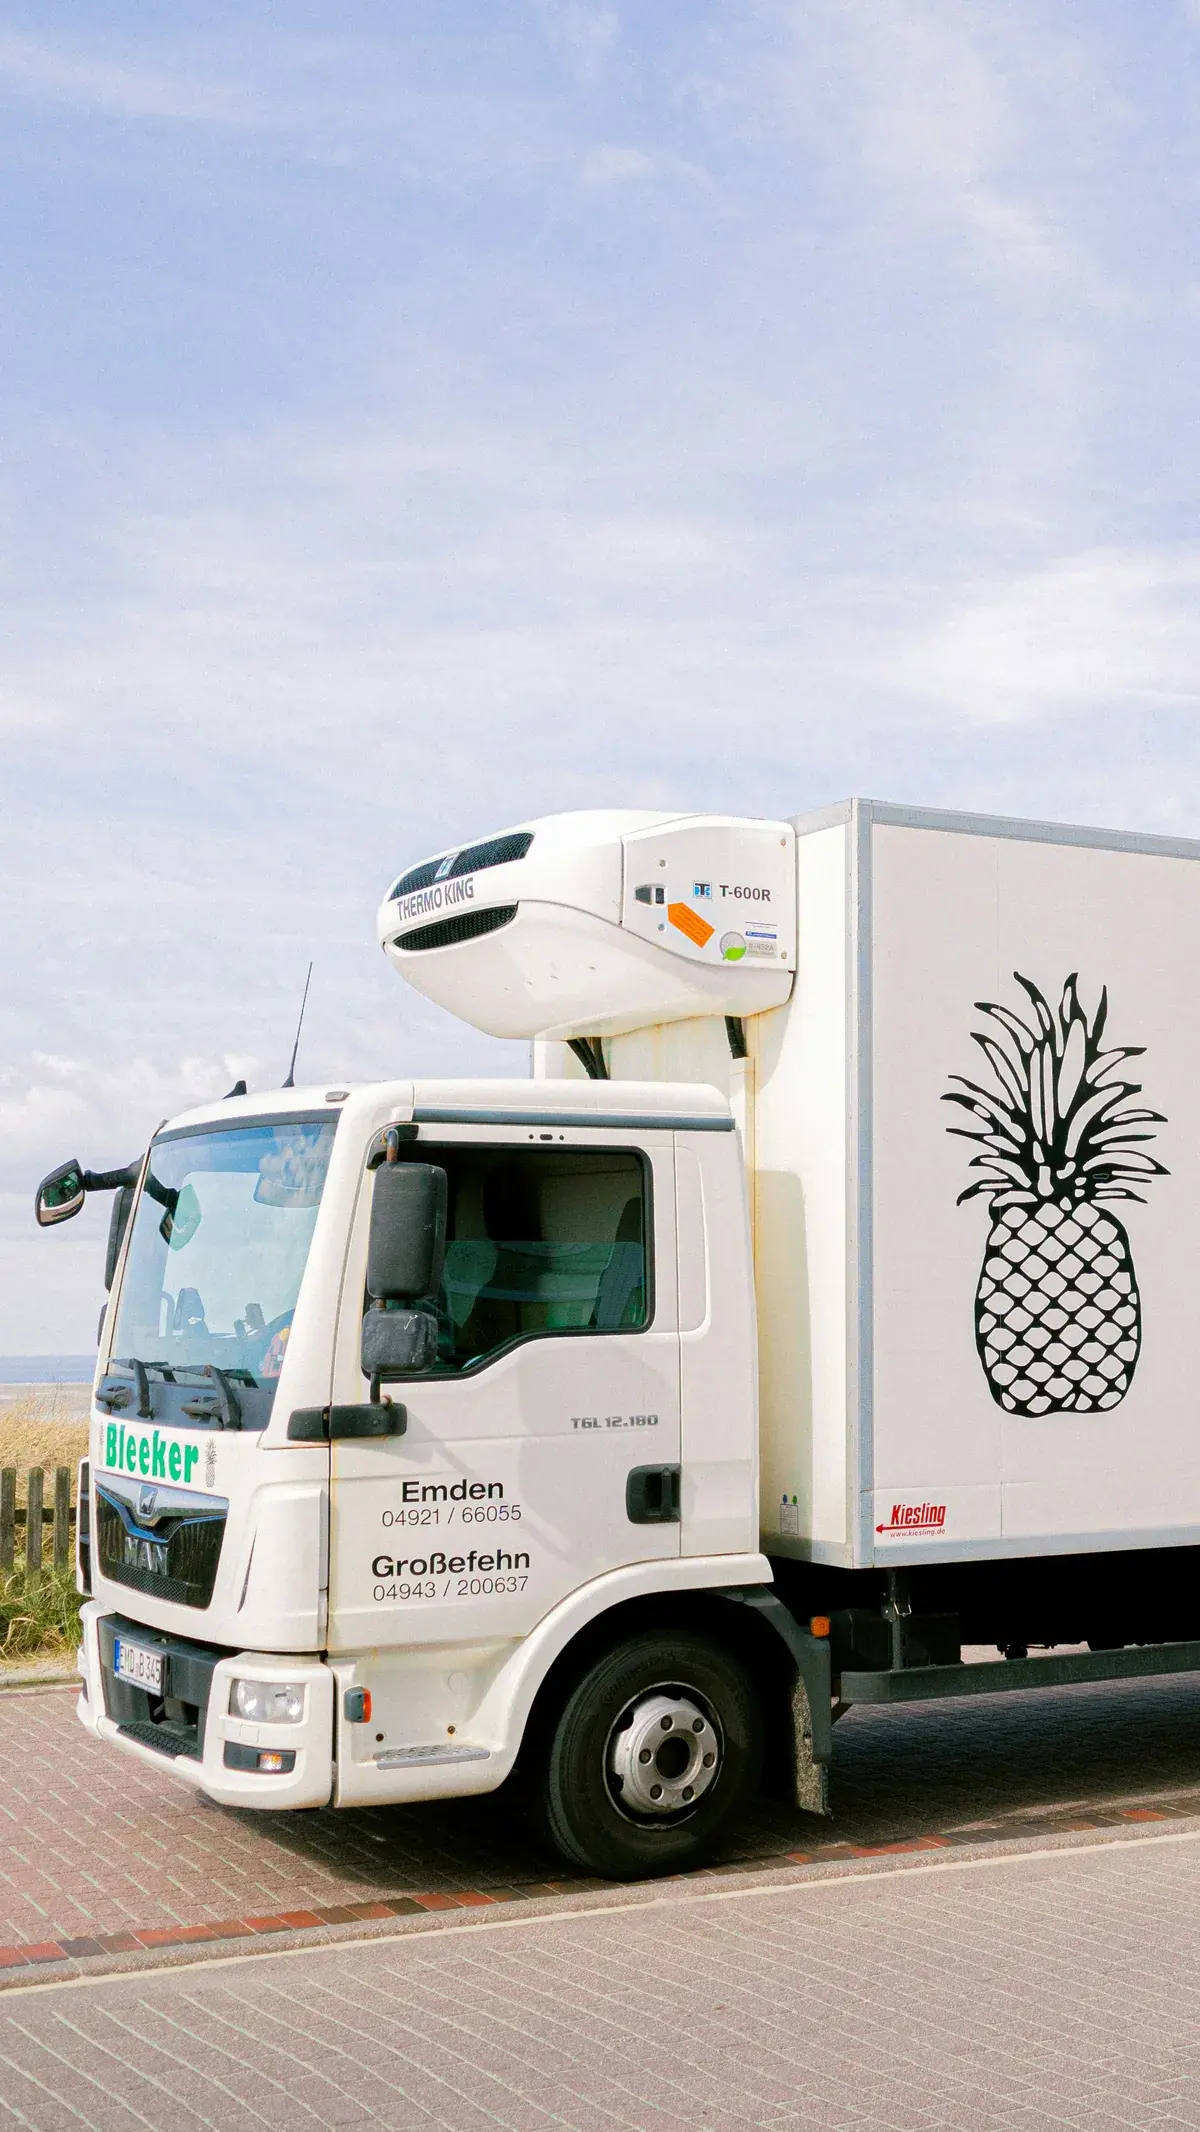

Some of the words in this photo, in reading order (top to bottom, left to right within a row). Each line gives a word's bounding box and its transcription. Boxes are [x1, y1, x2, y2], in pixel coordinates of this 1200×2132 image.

[397, 888, 442, 921] THERMO
[445, 876, 474, 905] KING
[719, 884, 771, 902] T-600R
[570, 1417, 602, 1429] TGL
[605, 1414, 659, 1428] 12.180
[106, 1422, 199, 1483] Bleeker
[401, 1479, 504, 1503] Emden
[382, 1508, 440, 1527] 04921
[462, 1505, 522, 1523] 66055
[890, 1503, 947, 1526] Kiesling
[890, 1527, 946, 1538] www.kiesling.de
[124, 1536, 169, 1576] MAN
[371, 1550, 530, 1577] Großefehn
[373, 1582, 436, 1602] 04943
[457, 1576, 529, 1596] 200637
